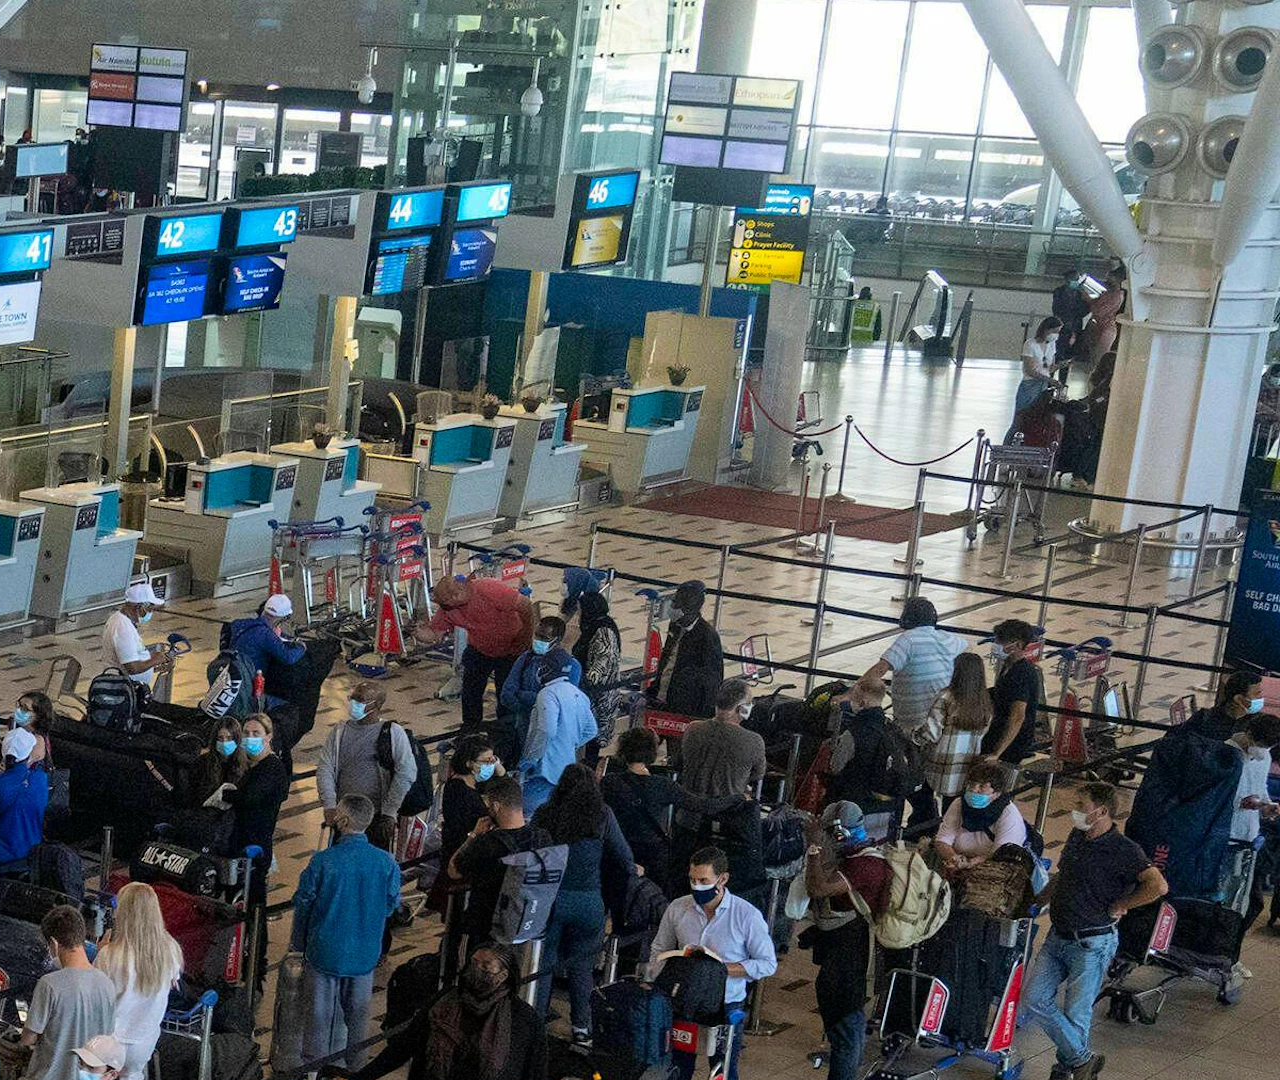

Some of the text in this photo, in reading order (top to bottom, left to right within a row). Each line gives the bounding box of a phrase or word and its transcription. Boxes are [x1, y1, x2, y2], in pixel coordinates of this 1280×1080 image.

[735, 88, 781, 99] Ethiopian
[488, 187, 510, 212] 45
[588, 179, 608, 203] 46
[273, 209, 296, 236] 43
[390, 197, 412, 223] 44
[159, 220, 184, 248] 42
[753, 241, 773, 249] Prayer
[27, 235, 51, 262] 41
[4, 312, 27, 321] TOWN
[1245, 590, 1263, 600] SELF
[1252, 601, 1270, 611] BAG
[206, 679, 242, 719] DREAM
[141, 846, 191, 875] ALL STAR
